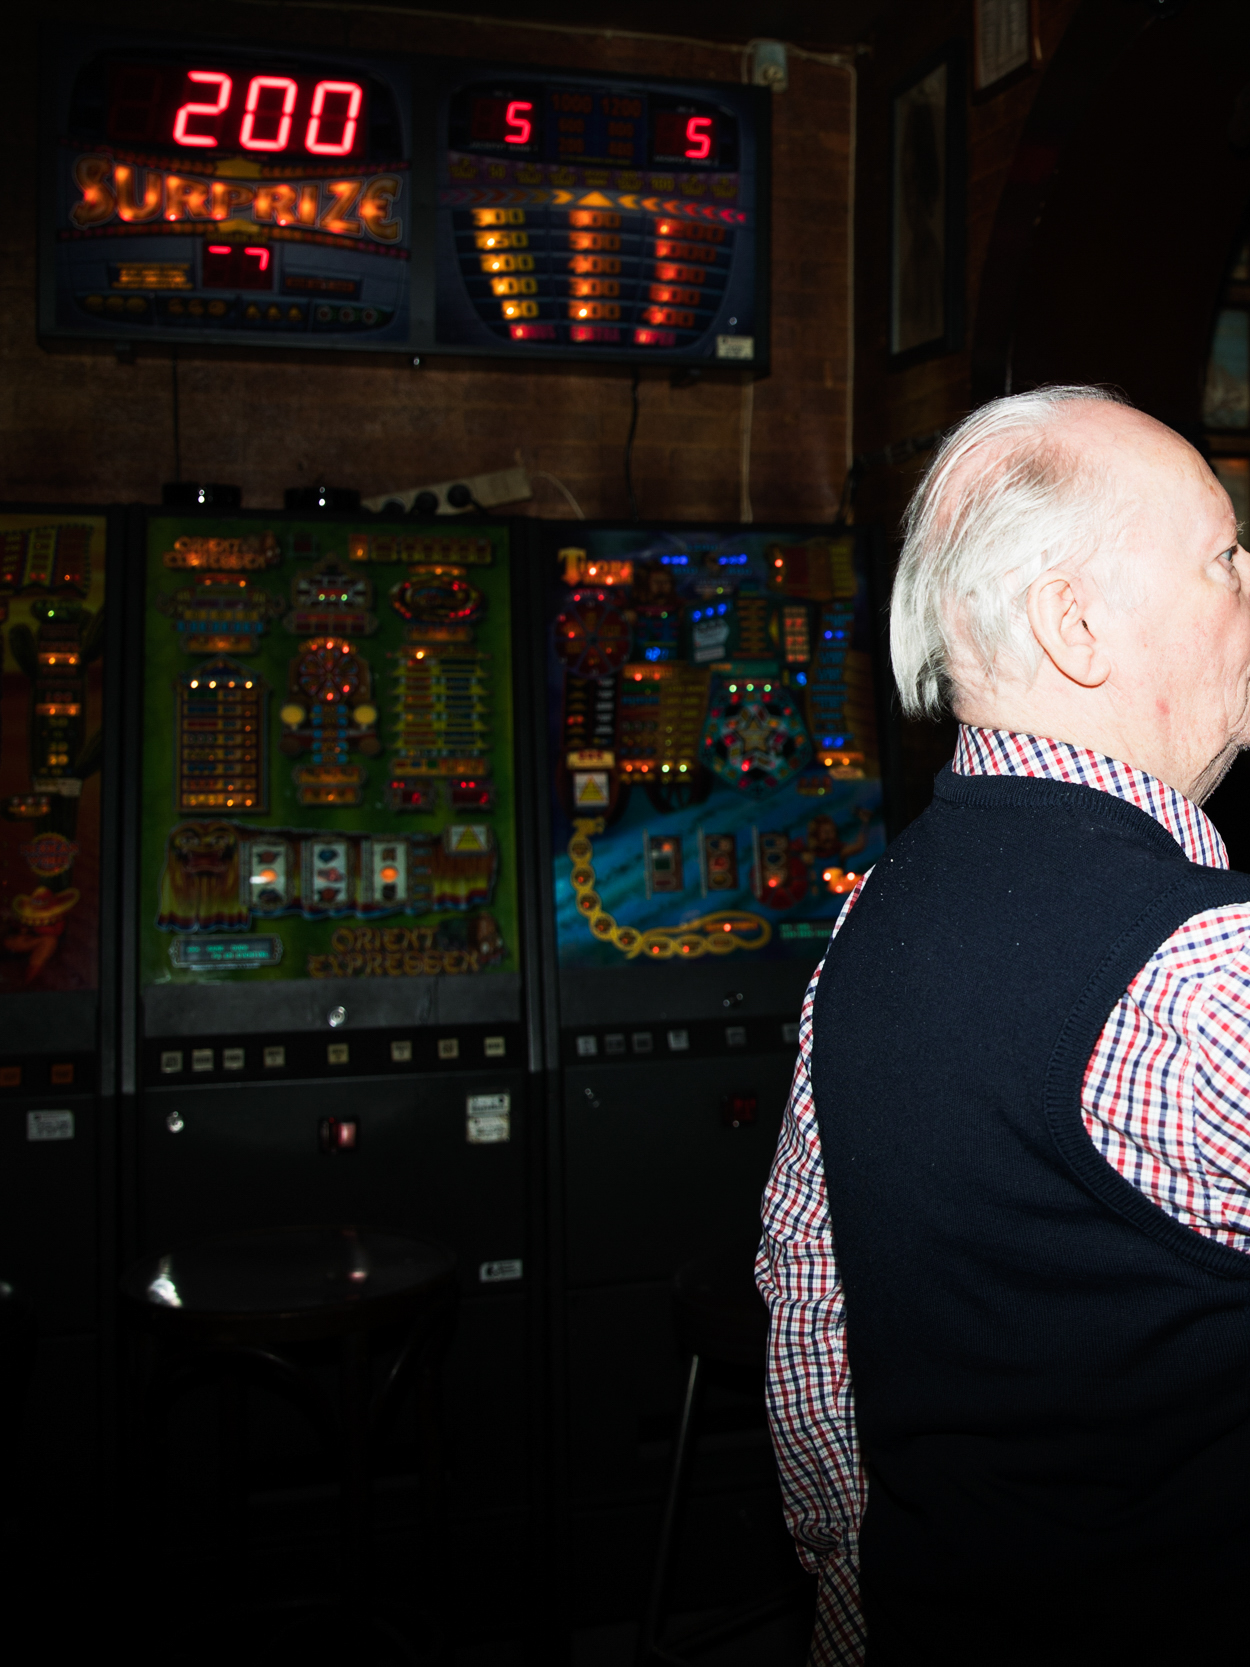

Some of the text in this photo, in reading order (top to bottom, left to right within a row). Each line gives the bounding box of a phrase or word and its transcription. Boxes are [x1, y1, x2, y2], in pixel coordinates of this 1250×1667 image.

[173, 71, 363, 156] 200
[505, 100, 533, 144] 5
[684, 115, 712, 159] 5
[70, 152, 402, 243] SURPRIZE
